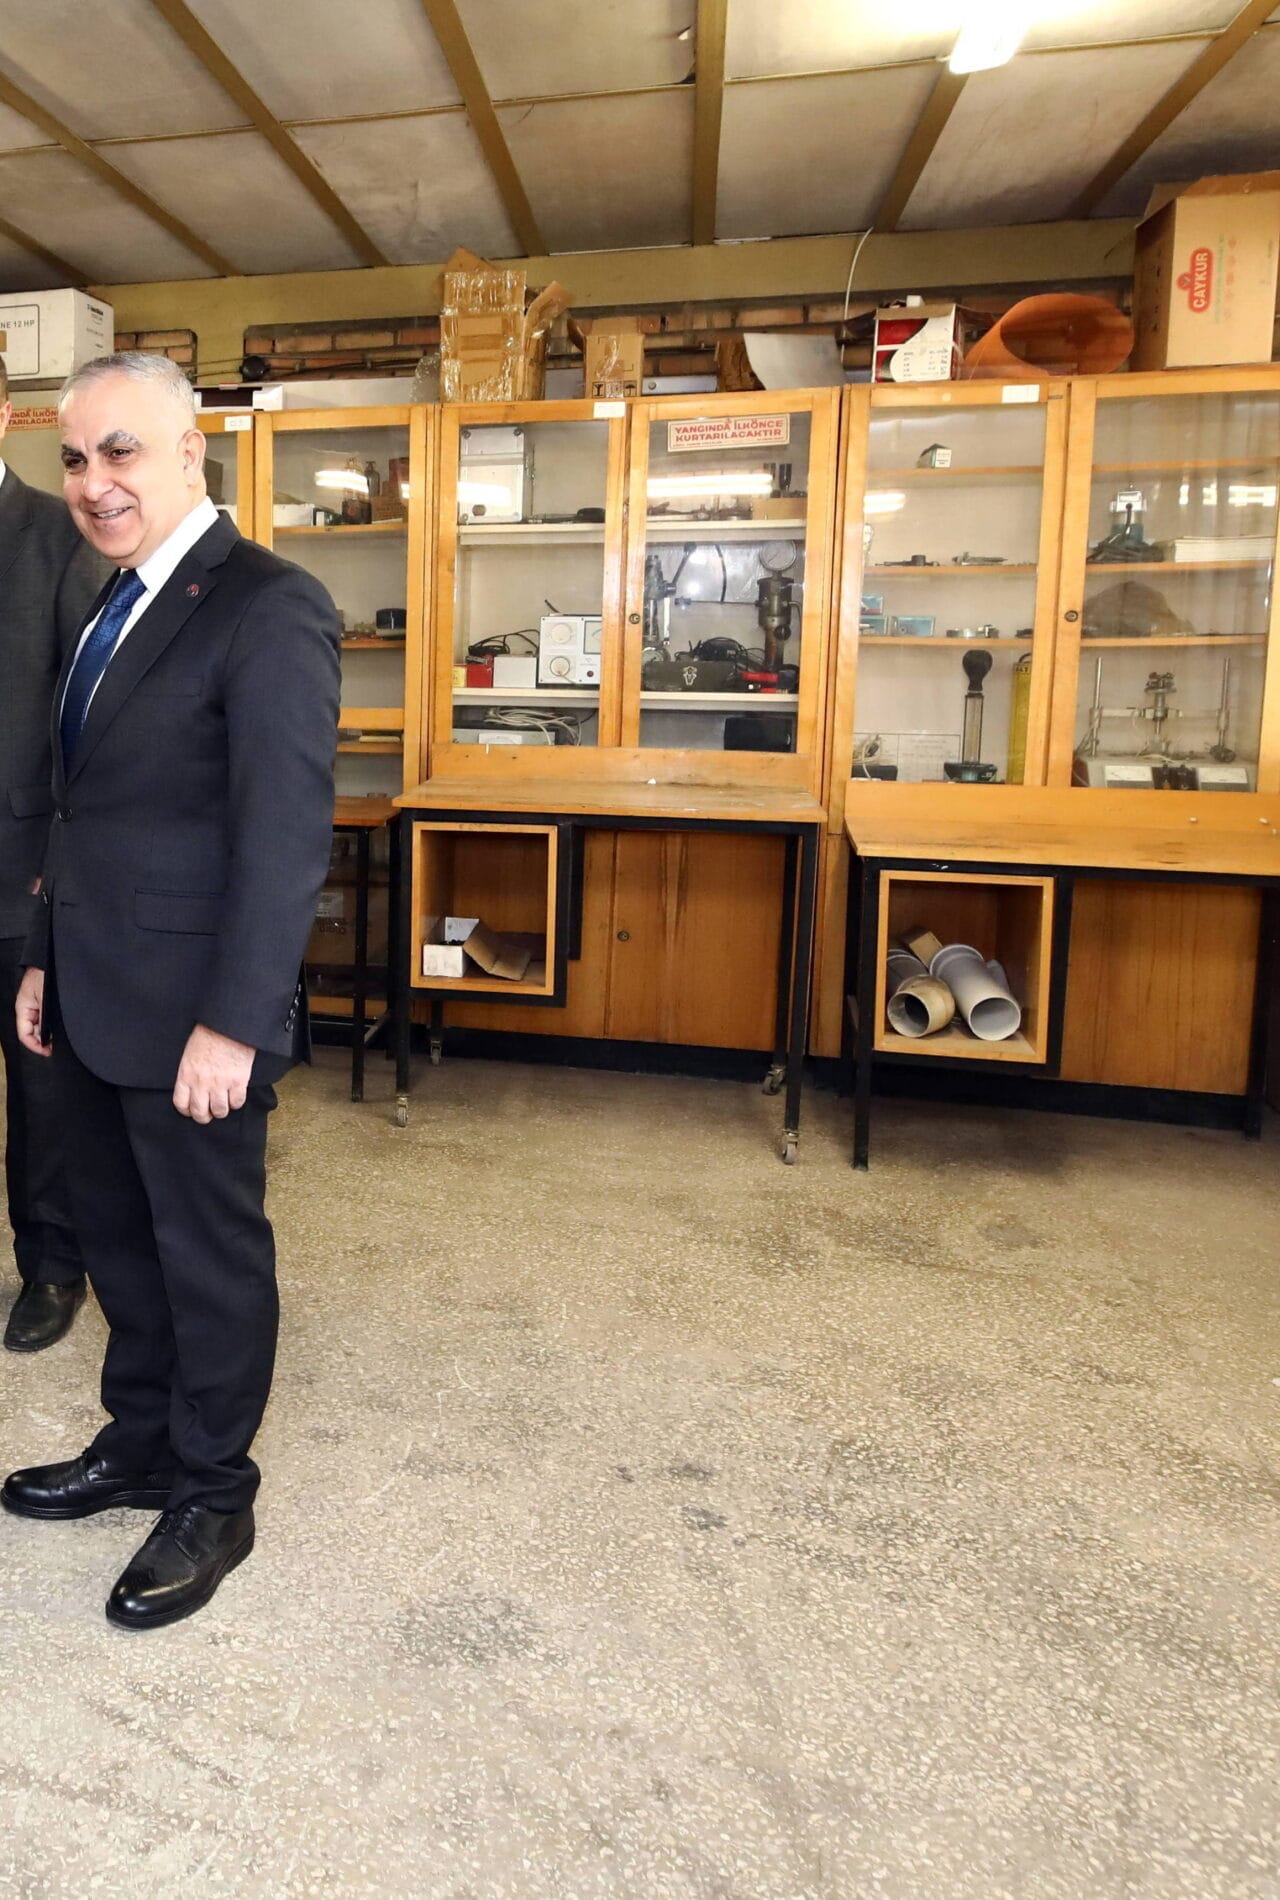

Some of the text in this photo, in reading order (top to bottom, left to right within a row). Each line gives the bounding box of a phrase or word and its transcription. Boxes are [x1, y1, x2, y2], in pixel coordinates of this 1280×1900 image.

[23, 319, 35, 328] HP
[674, 418, 783, 434] YANGINDA İLKÖNCE
[675, 429, 782, 442] KURTARILACAKTIR
